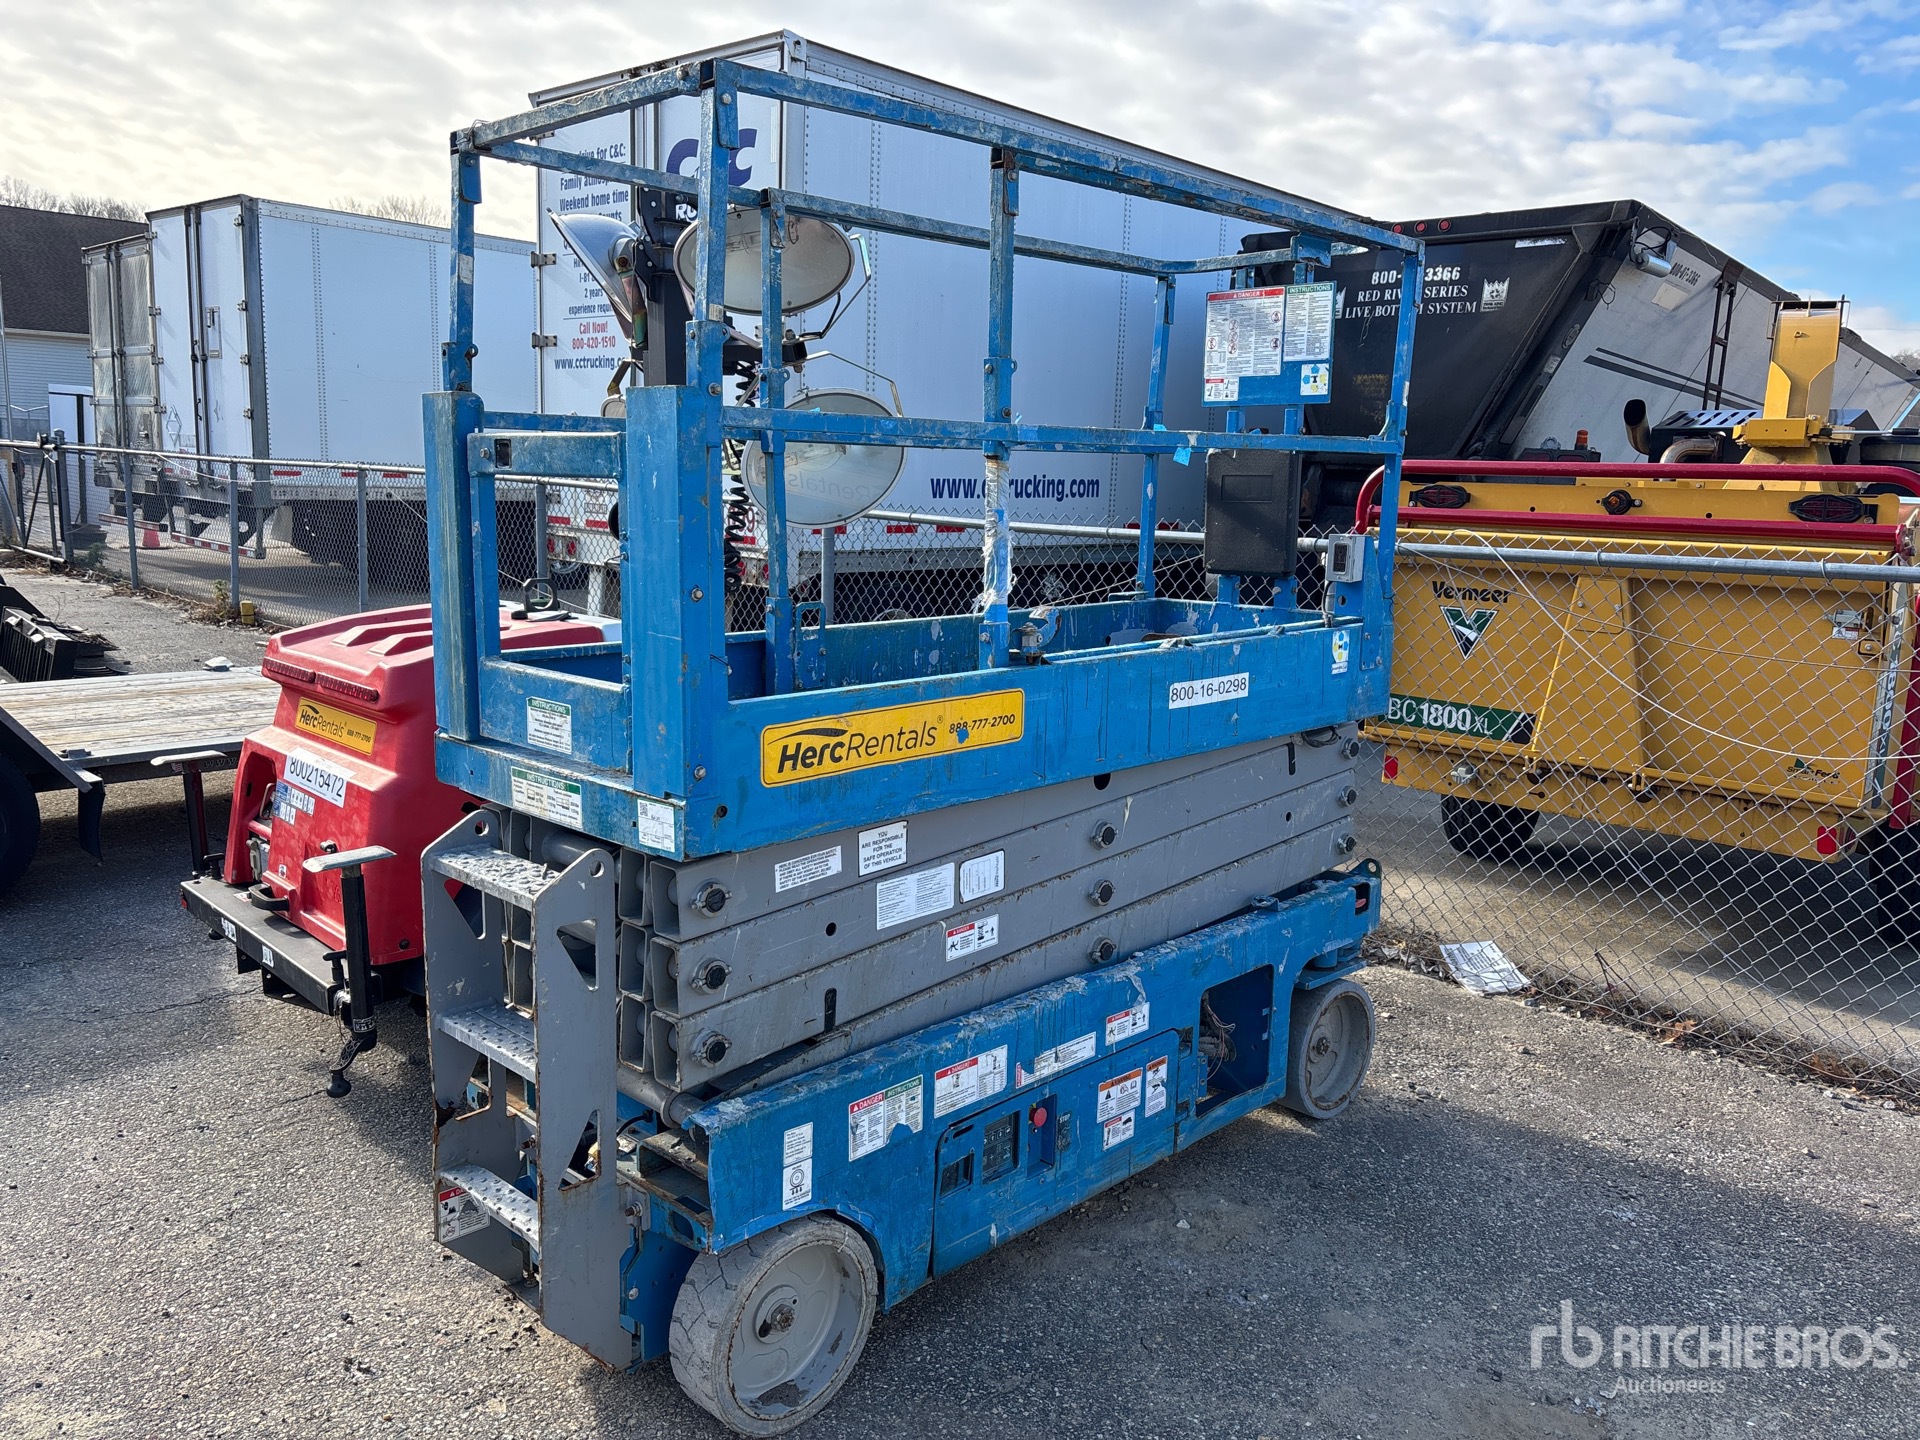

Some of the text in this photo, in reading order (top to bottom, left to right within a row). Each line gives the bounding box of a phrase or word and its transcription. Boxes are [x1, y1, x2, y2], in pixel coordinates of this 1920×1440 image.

[560, 175, 582, 191] Family
[560, 189, 629, 211] Weekend home time
[584, 288, 604, 299] 2 years
[1290, 285, 1330, 293] INSTRUCTIONS
[1357, 288, 1382, 303] RED
[1423, 285, 1469, 299] SERIES
[569, 304, 596, 316] experience
[1345, 304, 1371, 319] LIVE
[1427, 300, 1477, 314] SYSTEM
[579, 321, 609, 335] Call Now!
[572, 336, 616, 350] 800-420-1510
[1432, 580, 1512, 603] Vermeer
[1170, 677, 1247, 702] 800-16-0298
[531, 700, 567, 714] INSTRUCTIONS
[299, 709, 345, 738] HercRentals
[1419, 702, 1472, 731] 1800
[777, 713, 1015, 774] HercRentals 888-777-2700
[526, 774, 565, 790] INSTRUCTIONS
[872, 833, 904, 846] RESPONSIBLE
[877, 830, 888, 838] YOU
[863, 847, 903, 863] SAFE OPERATION
[872, 845, 883, 853] FOR
[872, 859, 882, 867] THIS
[883, 854, 902, 864] VEHICLE
[888, 1080, 920, 1097] INSTRUCTIONS
[859, 1094, 883, 1109] DANGER
